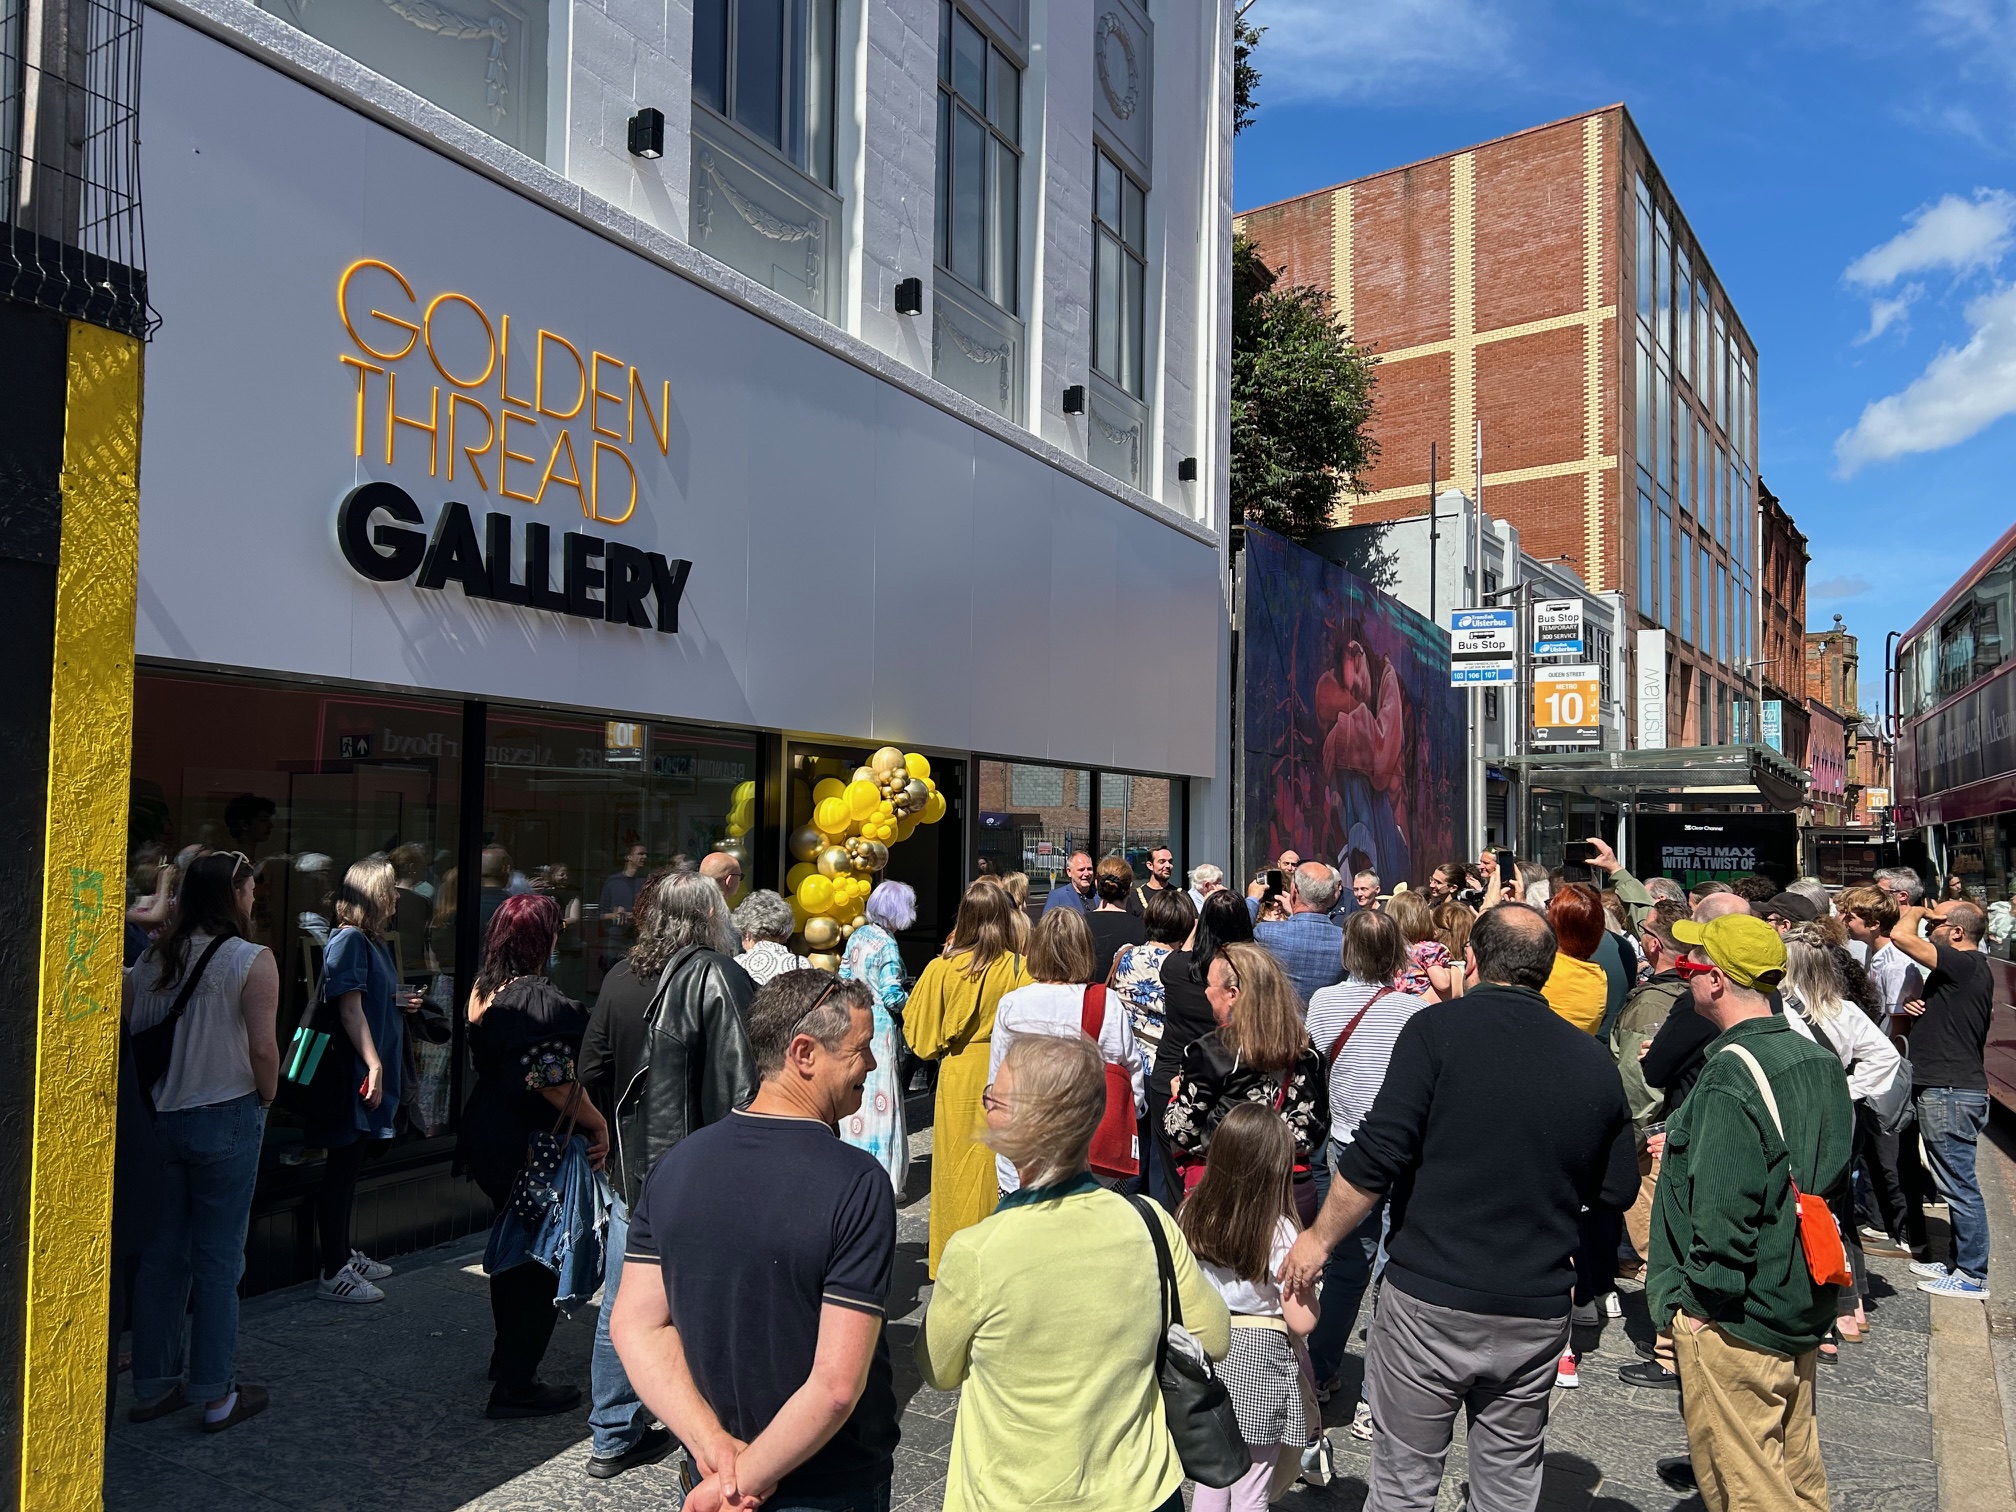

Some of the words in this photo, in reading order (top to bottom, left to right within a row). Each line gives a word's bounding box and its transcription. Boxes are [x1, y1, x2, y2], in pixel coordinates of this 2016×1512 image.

[337, 258, 671, 457] GOLDEN
[339, 355, 639, 525] THREAD
[337, 481, 693, 634] GALLERY
[1472, 619, 1507, 627] Ulsterbus
[1538, 614, 1556, 623] Bus
[1558, 613, 1580, 622] Stop
[1458, 641, 1479, 650] Bus
[1481, 640, 1506, 650] Stop
[1453, 672, 1464, 680] 103
[1590, 683, 1597, 692] B
[1590, 699, 1597, 707] J
[1545, 692, 1584, 725] 10
[1590, 714, 1597, 722] X
[1870, 796, 1883, 806] 10
[1661, 846, 1712, 856] PEPSI
[1714, 847, 1755, 857] MAX
[1662, 856, 1691, 869] WITH
[1692, 857, 1702, 869] A
[1702, 857, 1739, 870] TWIST
[1740, 858, 1756, 870] OF
